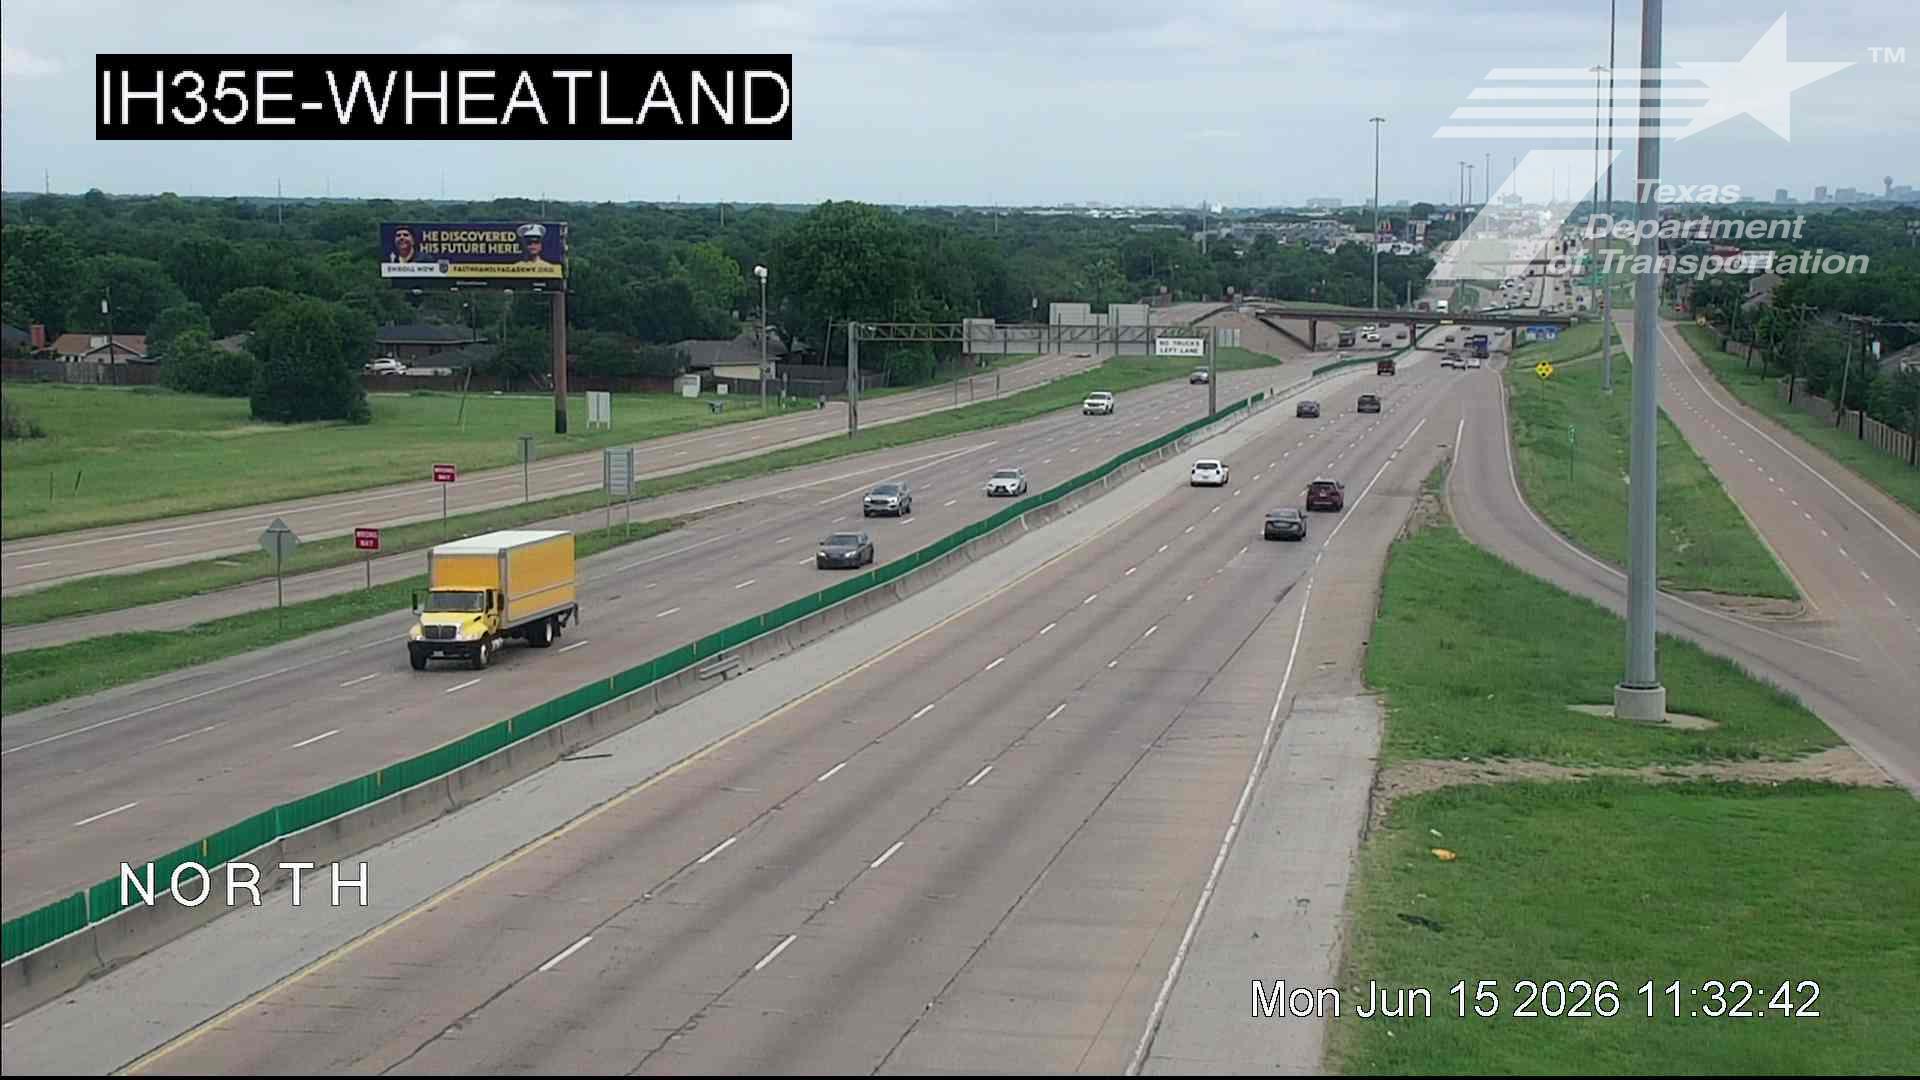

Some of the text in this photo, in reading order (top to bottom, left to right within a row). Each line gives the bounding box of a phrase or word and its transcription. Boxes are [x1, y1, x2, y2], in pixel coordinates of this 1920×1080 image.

[423, 231, 517, 242] HE DISCOVERED
[420, 243, 523, 254] HIS FUTURE HERE.
